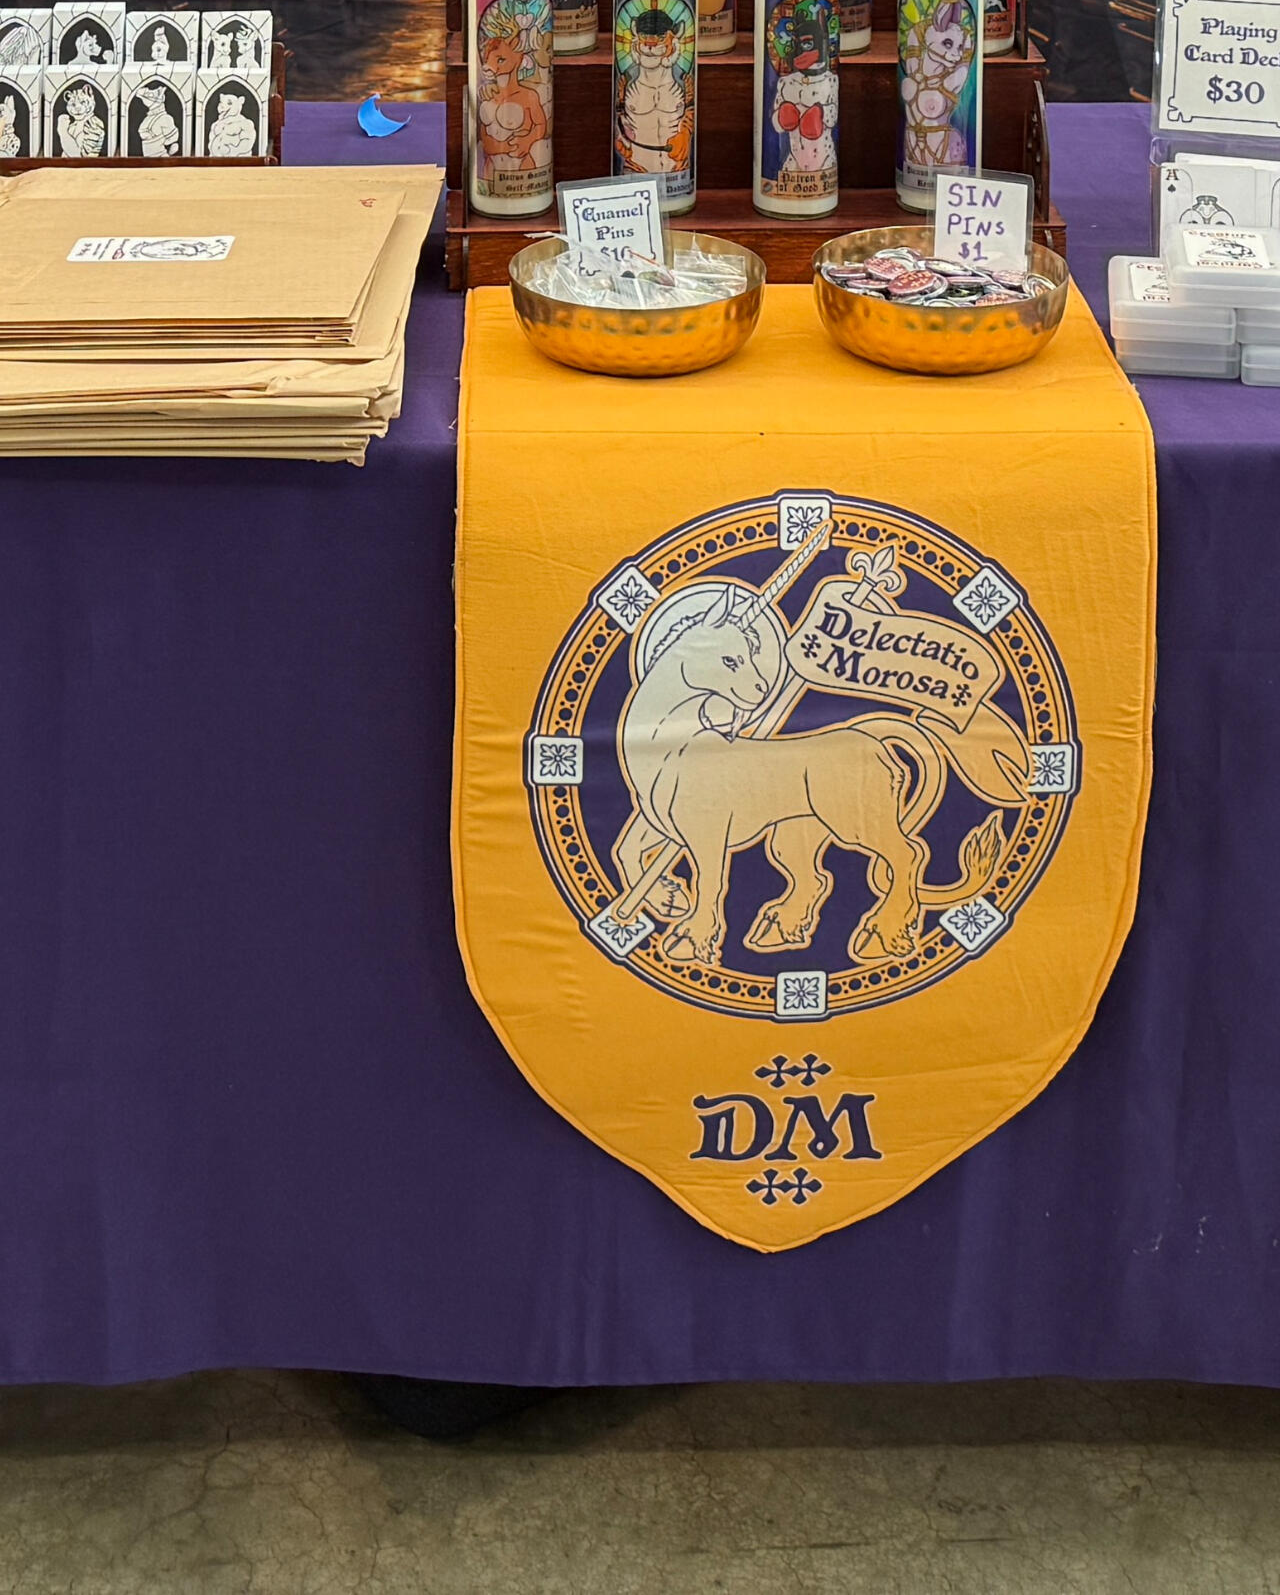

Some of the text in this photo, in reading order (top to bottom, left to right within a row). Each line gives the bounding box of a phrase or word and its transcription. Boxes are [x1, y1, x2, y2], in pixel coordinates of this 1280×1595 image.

[1200, 17, 1278, 43] Playing
[1184, 44, 1234, 64] Card
[1206, 74, 1265, 104] $30
[781, 172, 816, 184] Patron
[1166, 168, 1179, 181] A
[793, 183, 819, 194] Good
[948, 183, 1002, 208] SIN
[581, 203, 645, 223] Enamel
[596, 225, 635, 241] Pins
[947, 213, 1005, 237] PINS
[958, 240, 989, 262] $1
[820, 601, 980, 684] Delectatio
[817, 646, 951, 702] Morosa
[689, 1093, 883, 1162] DM
